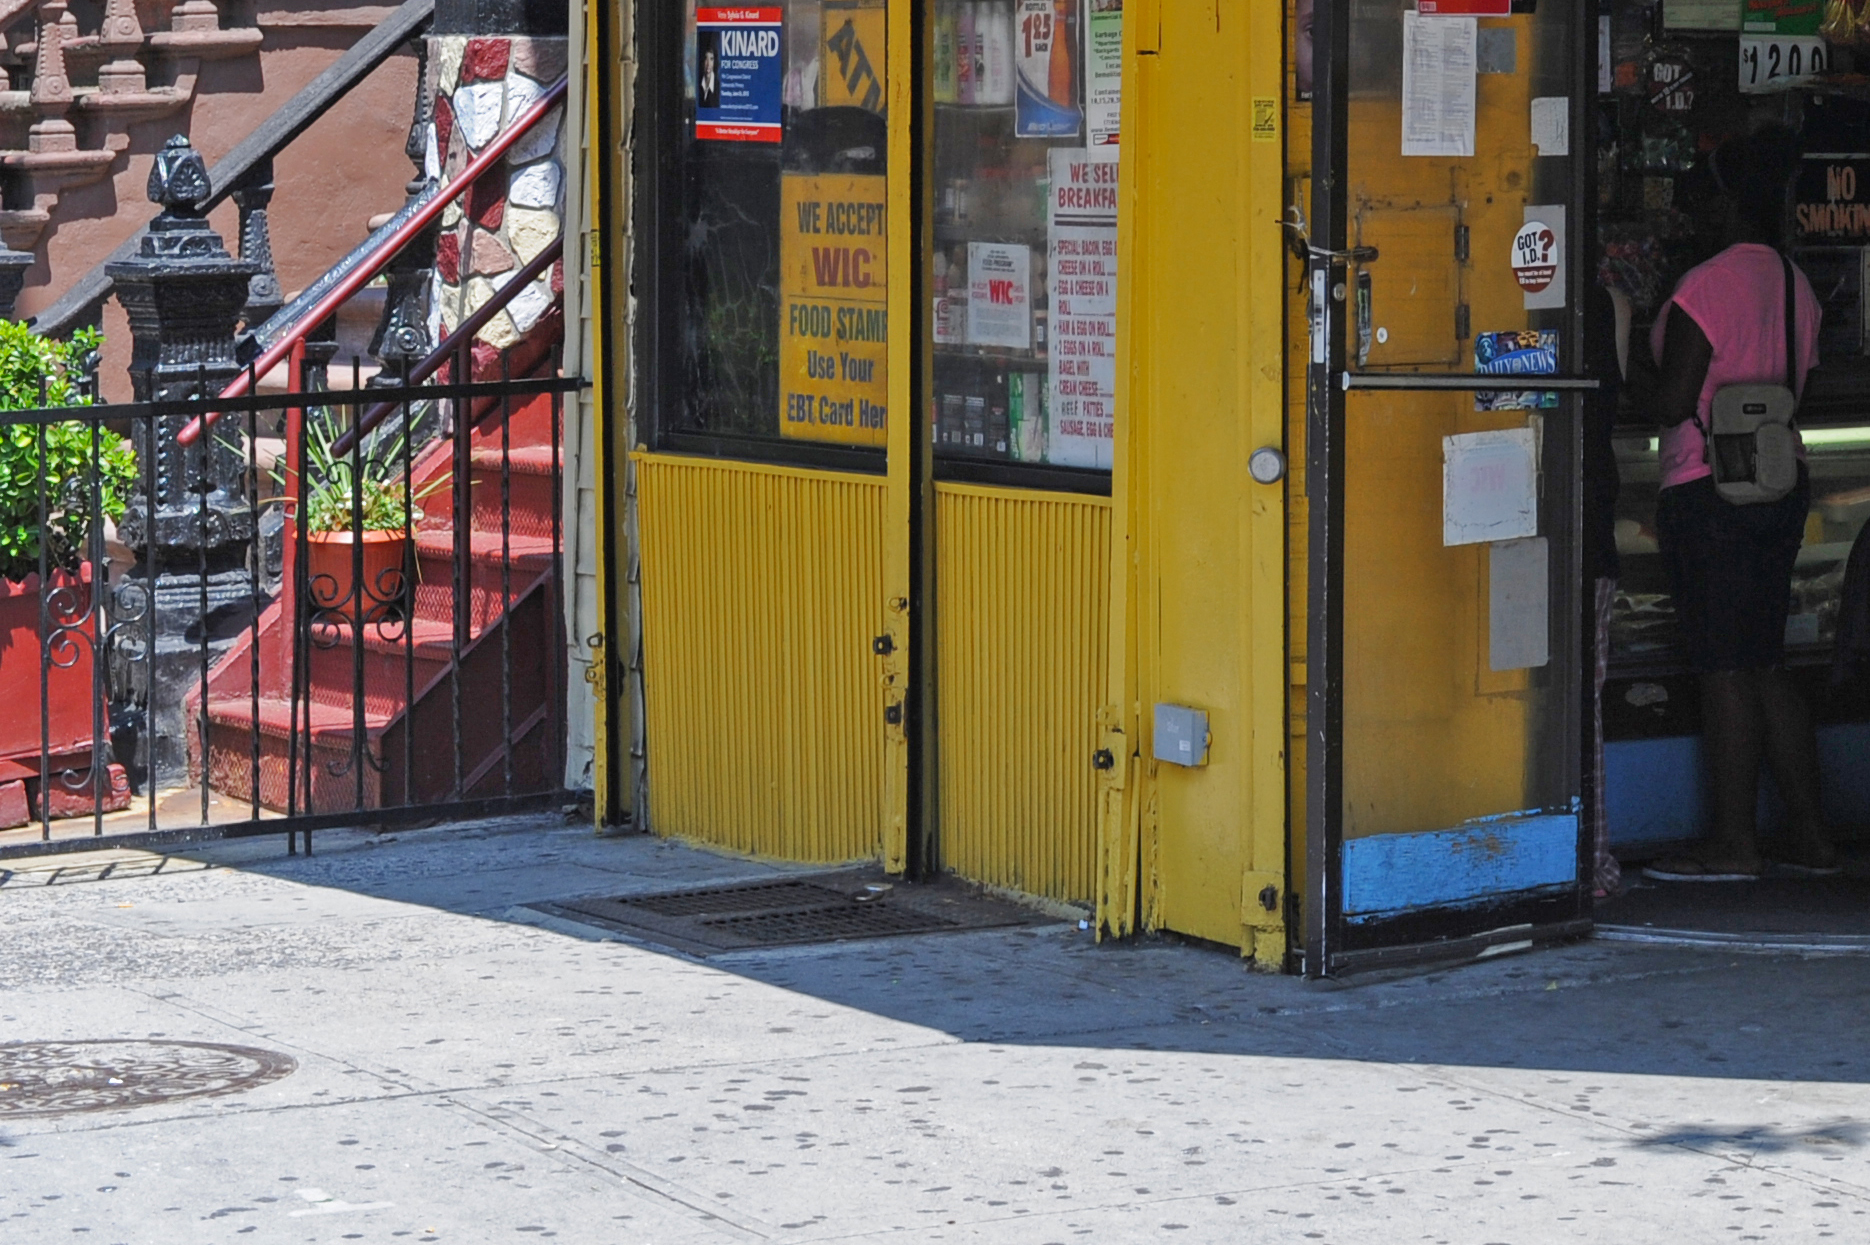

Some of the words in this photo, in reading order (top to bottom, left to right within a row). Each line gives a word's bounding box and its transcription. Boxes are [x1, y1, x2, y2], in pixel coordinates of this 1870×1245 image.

[721, 30, 779, 57] KINARD
[721, 59, 731, 69] FOR
[732, 59, 759, 70] CONGRESS
[1653, 62, 1682, 84] GOT
[1070, 163, 1089, 184] WE
[1826, 165, 1856, 200] NO
[797, 201, 821, 234] WE
[826, 202, 884, 236] ACCEPT
[1517, 231, 1537, 251] GOT
[812, 247, 872, 289] WIC
[1058, 259, 1077, 275] CHEESE
[1080, 260, 1086, 276] ON
[1093, 260, 1105, 276] ROLL
[989, 279, 1013, 305] WIC
[1058, 279, 1068, 296] EGG
[1075, 280, 1095, 296] CHEESE
[1097, 280, 1104, 296] ON
[1058, 299, 1071, 315] ROLL
[790, 303, 831, 339] FOOD
[1058, 319, 1070, 335] HAM
[1077, 320, 1087, 336] EGG
[1089, 320, 1096, 336] ON
[1097, 320, 1109, 336] ROLL
[1064, 340, 1077, 356] EGGS
[1079, 340, 1085, 356] ON
[1092, 340, 1105, 356] ROLL
[808, 350, 835, 380] Use
[840, 352, 875, 383] Your
[1059, 360, 1075, 376] BAGEL
[1077, 360, 1089, 376] WITH
[1521, 350, 1556, 373] NEWS
[1059, 379, 1077, 396] CREAM
[1079, 380, 1098, 396] CHEESE
[819, 396, 854, 427] Card
[860, 399, 886, 430] Her
[1083, 401, 1103, 417] PATTIES
[1086, 421, 1096, 437] EGG
